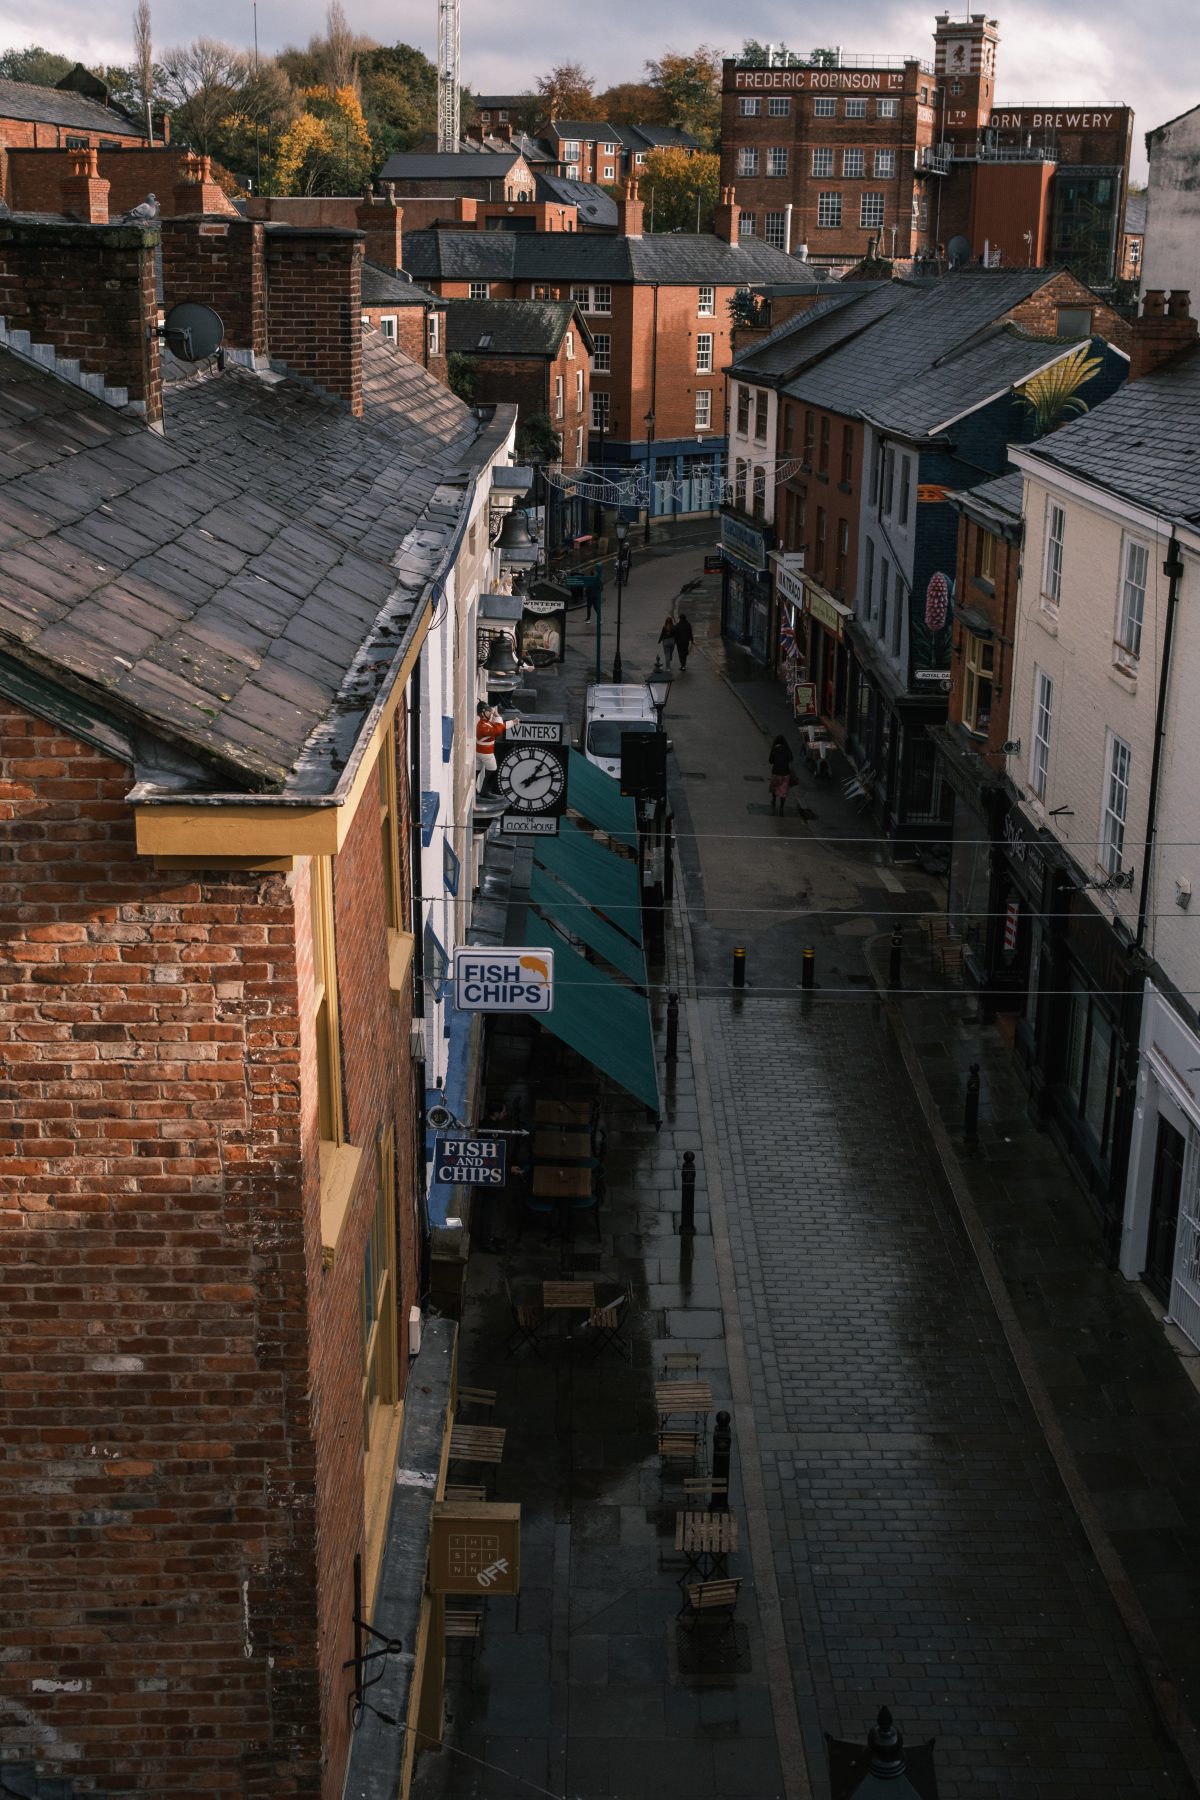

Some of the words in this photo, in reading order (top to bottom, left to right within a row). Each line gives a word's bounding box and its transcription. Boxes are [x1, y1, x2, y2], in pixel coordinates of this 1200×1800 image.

[736, 73, 804, 88] FREDERIC
[810, 73, 880, 89] ROBINSON
[887, 74, 904, 89] LTD
[1032, 113, 1113, 128] BREWERY
[511, 725, 557, 739] WINTER'S
[507, 822, 529, 830] CLOCK
[531, 823, 554, 831] HOUSE
[465, 965, 520, 983] FISH
[464, 984, 541, 1003] CHIPS
[442, 1141, 499, 1158] FISH
[456, 1157, 484, 1167] AND
[438, 1166, 502, 1183] CHIPS
[477, 1558, 509, 1587] OFF
